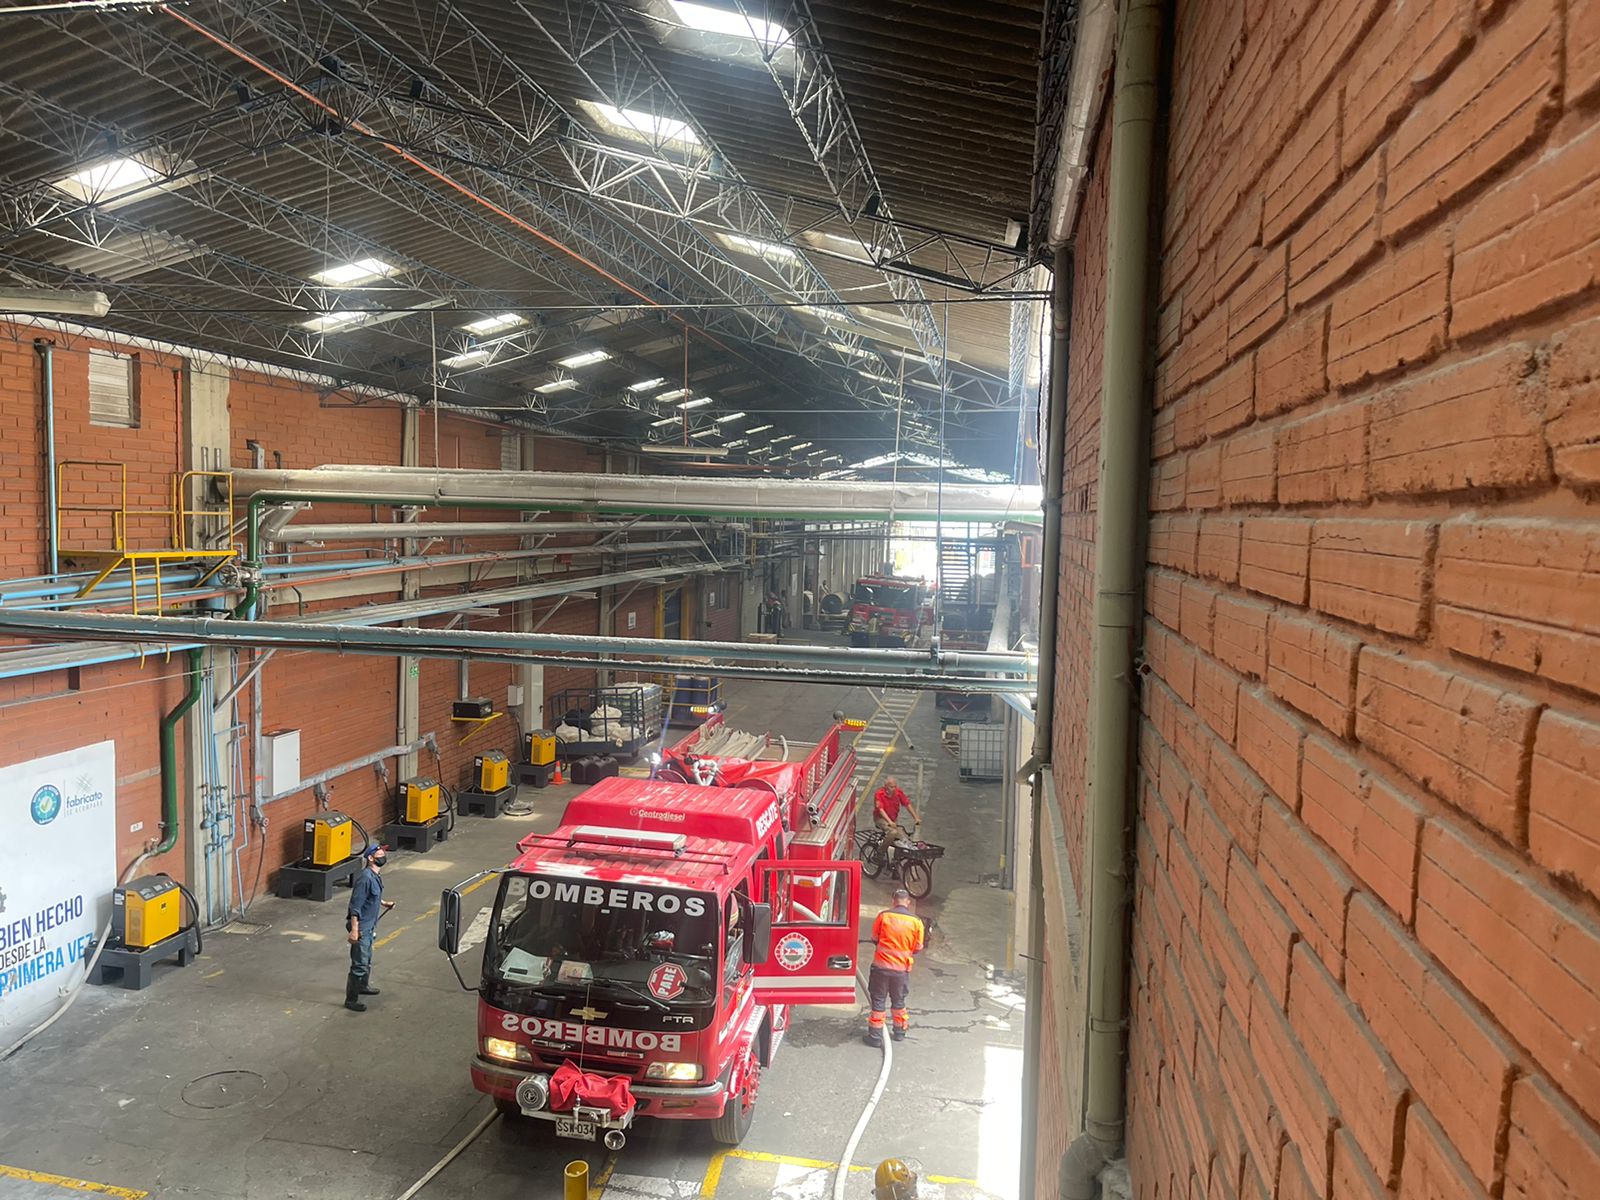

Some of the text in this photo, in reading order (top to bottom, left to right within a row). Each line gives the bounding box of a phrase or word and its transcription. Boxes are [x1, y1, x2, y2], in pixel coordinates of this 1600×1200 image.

[66, 792, 103, 809] fabricato
[755, 801, 778, 840] RESCATE
[507, 876, 705, 917] BOMBEROS
[0, 894, 84, 951] BIEN HECHO
[0, 936, 46, 971] DESDE LA
[0, 946, 65, 997] PRIMERA
[657, 966, 677, 997] PARE
[662, 1015, 694, 1024] FTR
